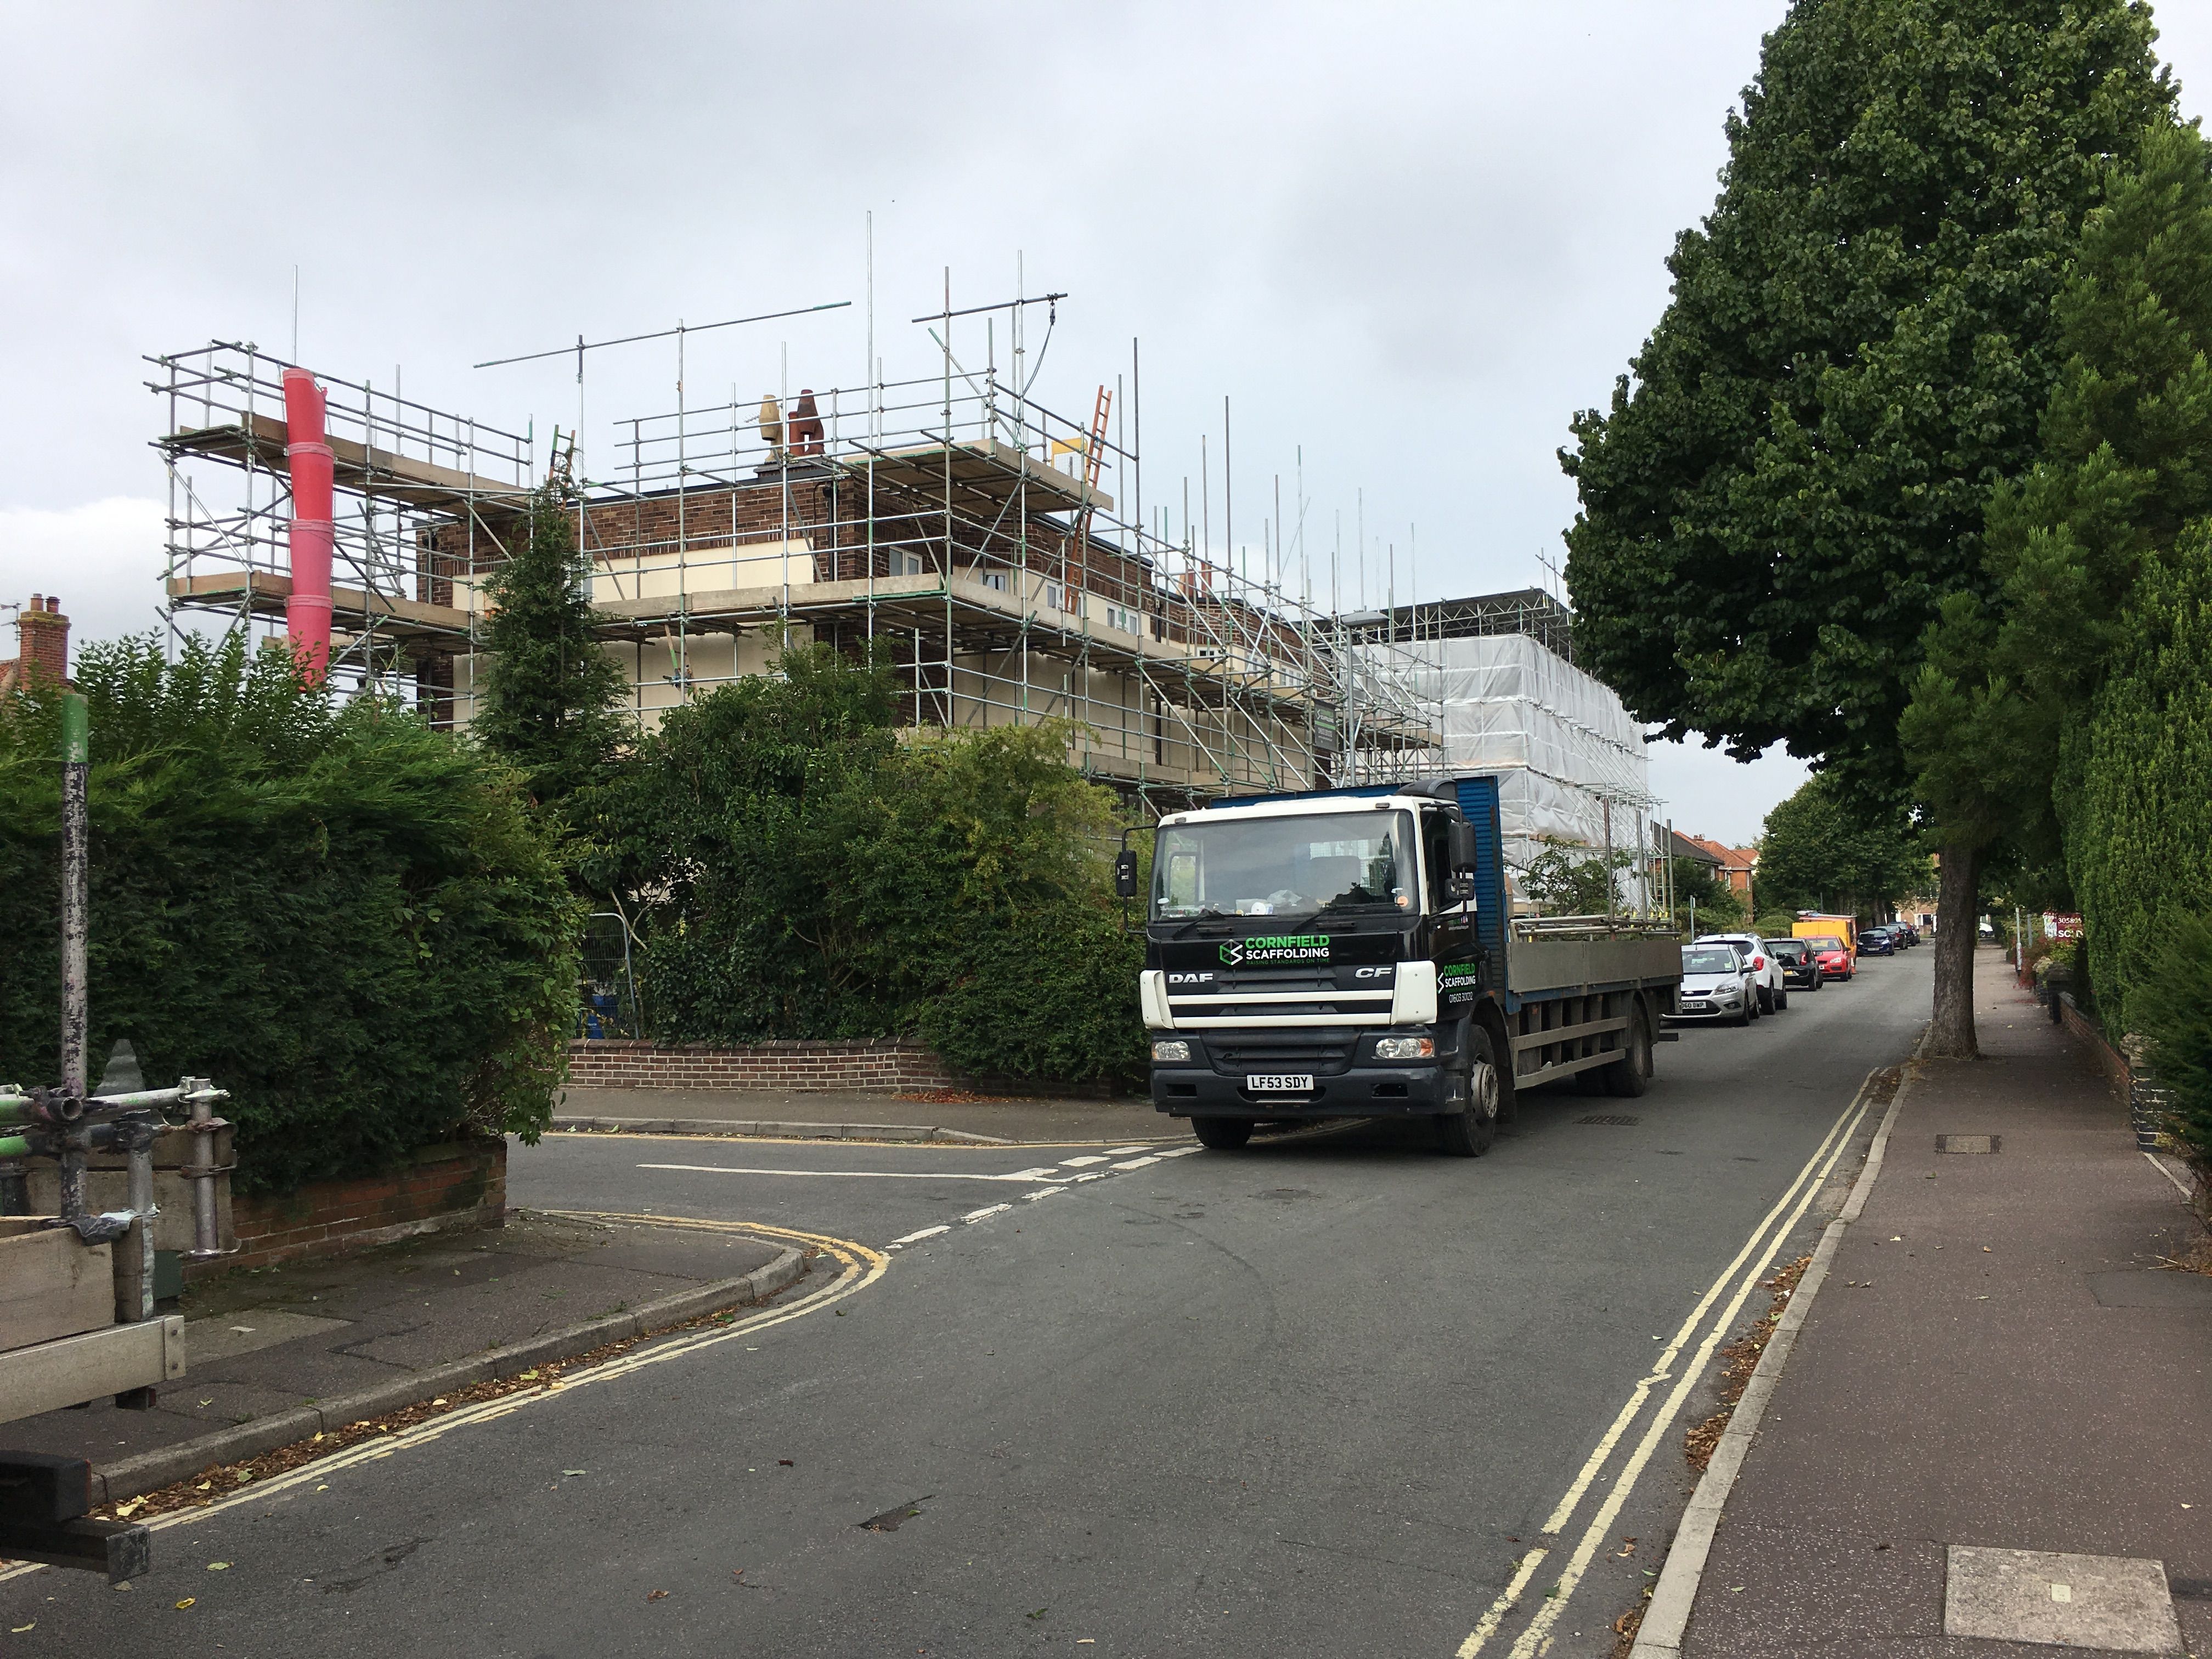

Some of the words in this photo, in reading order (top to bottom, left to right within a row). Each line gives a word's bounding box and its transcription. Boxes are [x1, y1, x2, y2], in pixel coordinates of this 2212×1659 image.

[1245, 935, 1330, 949] CORNFIELD
[1246, 947, 1329, 960] SCAFFOLDING
[1355, 967, 1392, 978] CF
[1444, 963, 1475, 977] CORNFIELD
[1169, 973, 1213, 983] DAF
[1445, 975, 1476, 988] SCAFFOLDING
[1252, 1077, 1282, 1088] LF53
[1285, 1077, 1307, 1088] SDY
